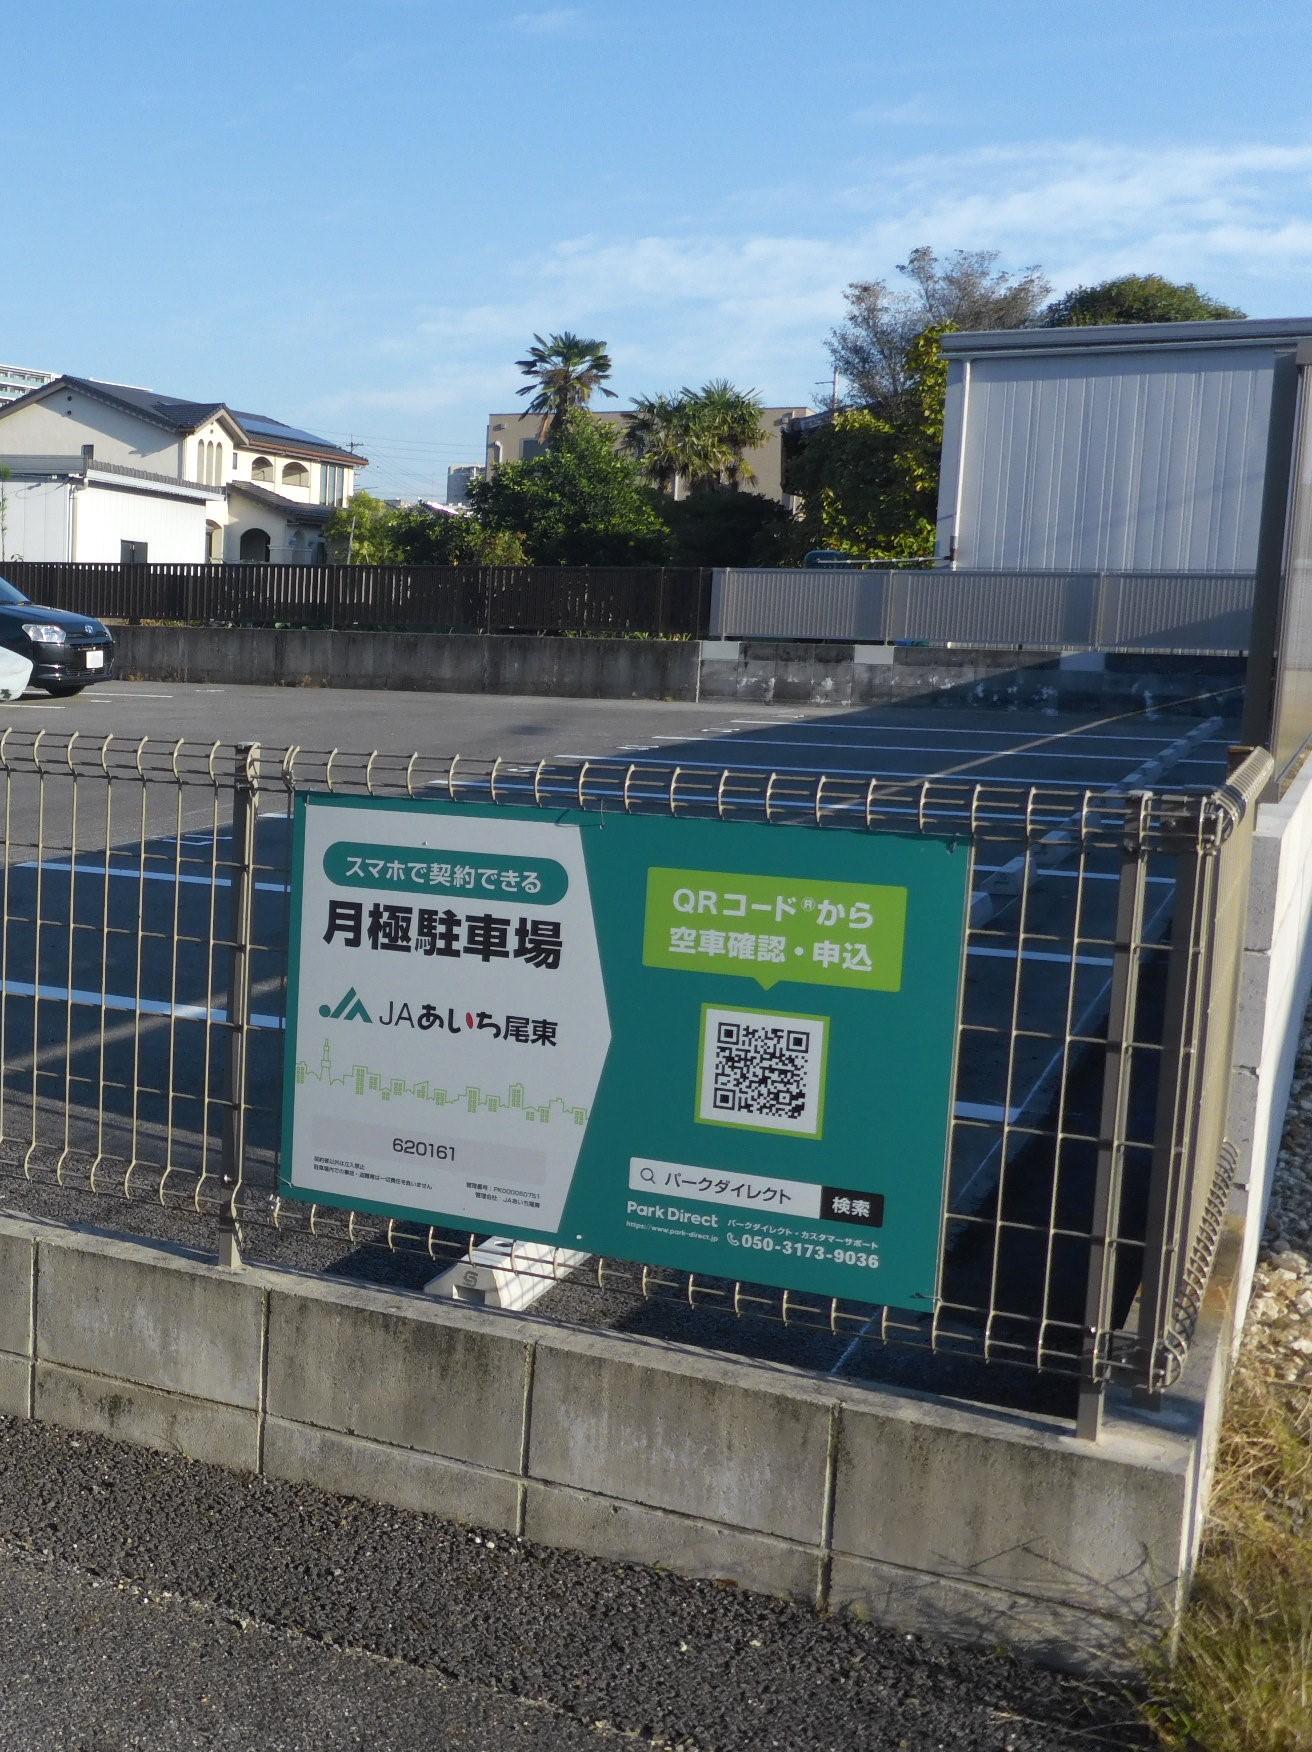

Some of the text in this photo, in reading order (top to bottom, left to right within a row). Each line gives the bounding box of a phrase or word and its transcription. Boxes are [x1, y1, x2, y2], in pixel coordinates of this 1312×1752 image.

[345, 856, 542, 894] スマホで契約できる
[323, 900, 564, 970] 月極駐車場
[669, 927, 873, 972] 空車確認・申込
[378, 1000, 558, 1048] JAあいち尾東
[392, 1137, 456, 1162] 620161
[664, 1172, 792, 1204] パークダイレクト
[626, 1200, 719, 1228] Park Direct
[831, 1196, 872, 1218] 検索
[625, 1220, 719, 1243] https://www.park-direct.jp
[727, 1218, 879, 1250] パークダイレクト・カスタマーサポート
[741, 1234, 880, 1269] 050-3173-9036
